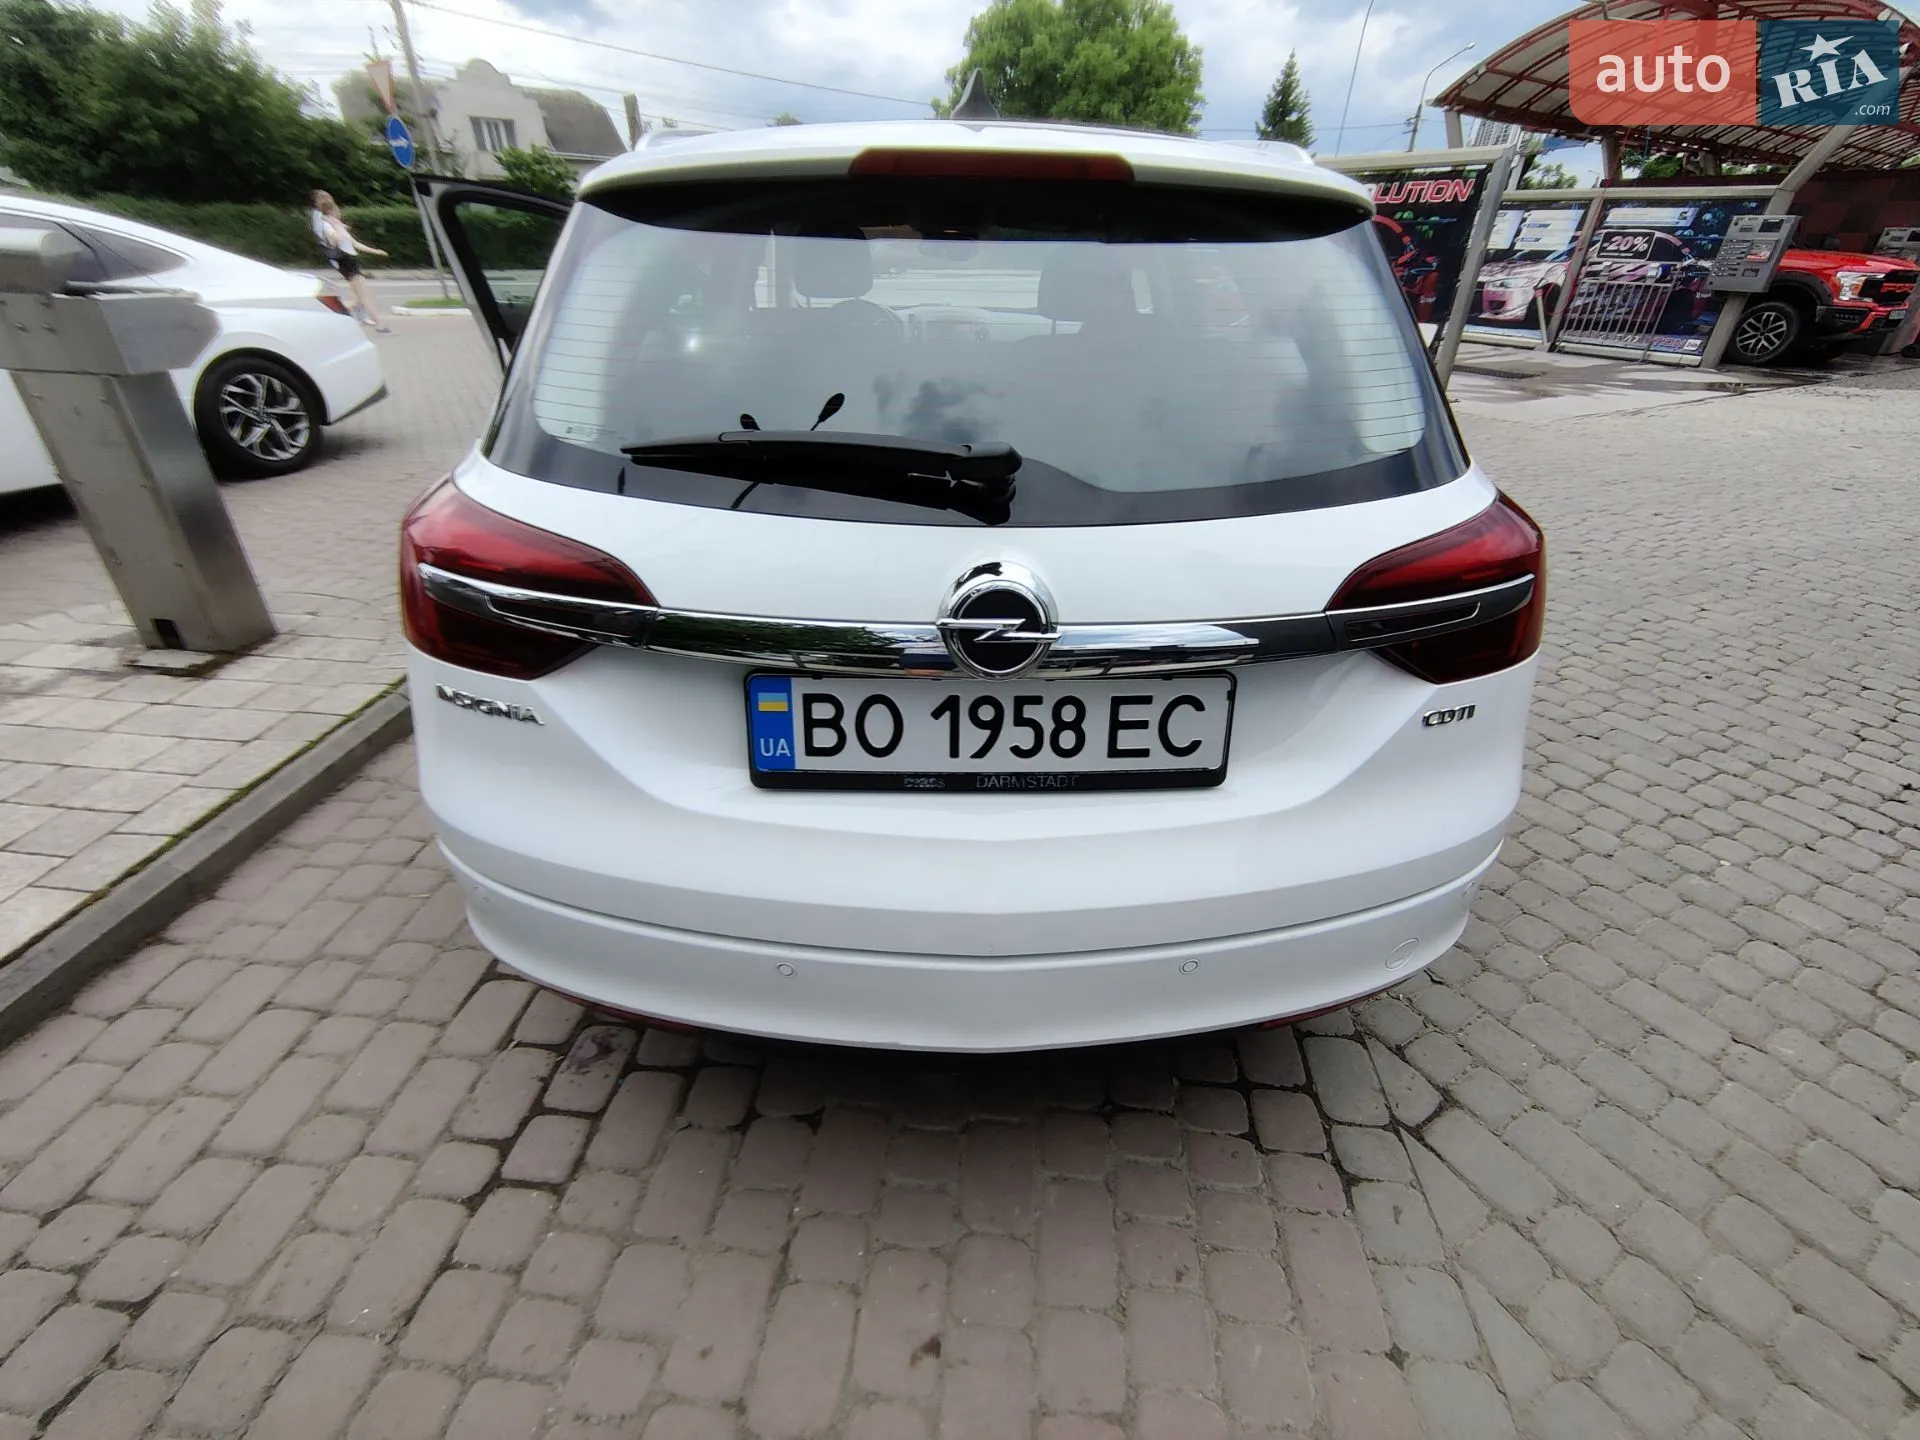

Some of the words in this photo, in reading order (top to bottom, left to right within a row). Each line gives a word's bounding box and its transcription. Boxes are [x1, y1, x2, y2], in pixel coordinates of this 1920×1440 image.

[802, 692, 904, 759] BO
[930, 693, 1087, 760] 1958
[1106, 694, 1206, 759] EC
[1422, 704, 1476, 727] CDTI
[760, 737, 791, 758] UA
[976, 774, 1079, 789] DARMSTADT
